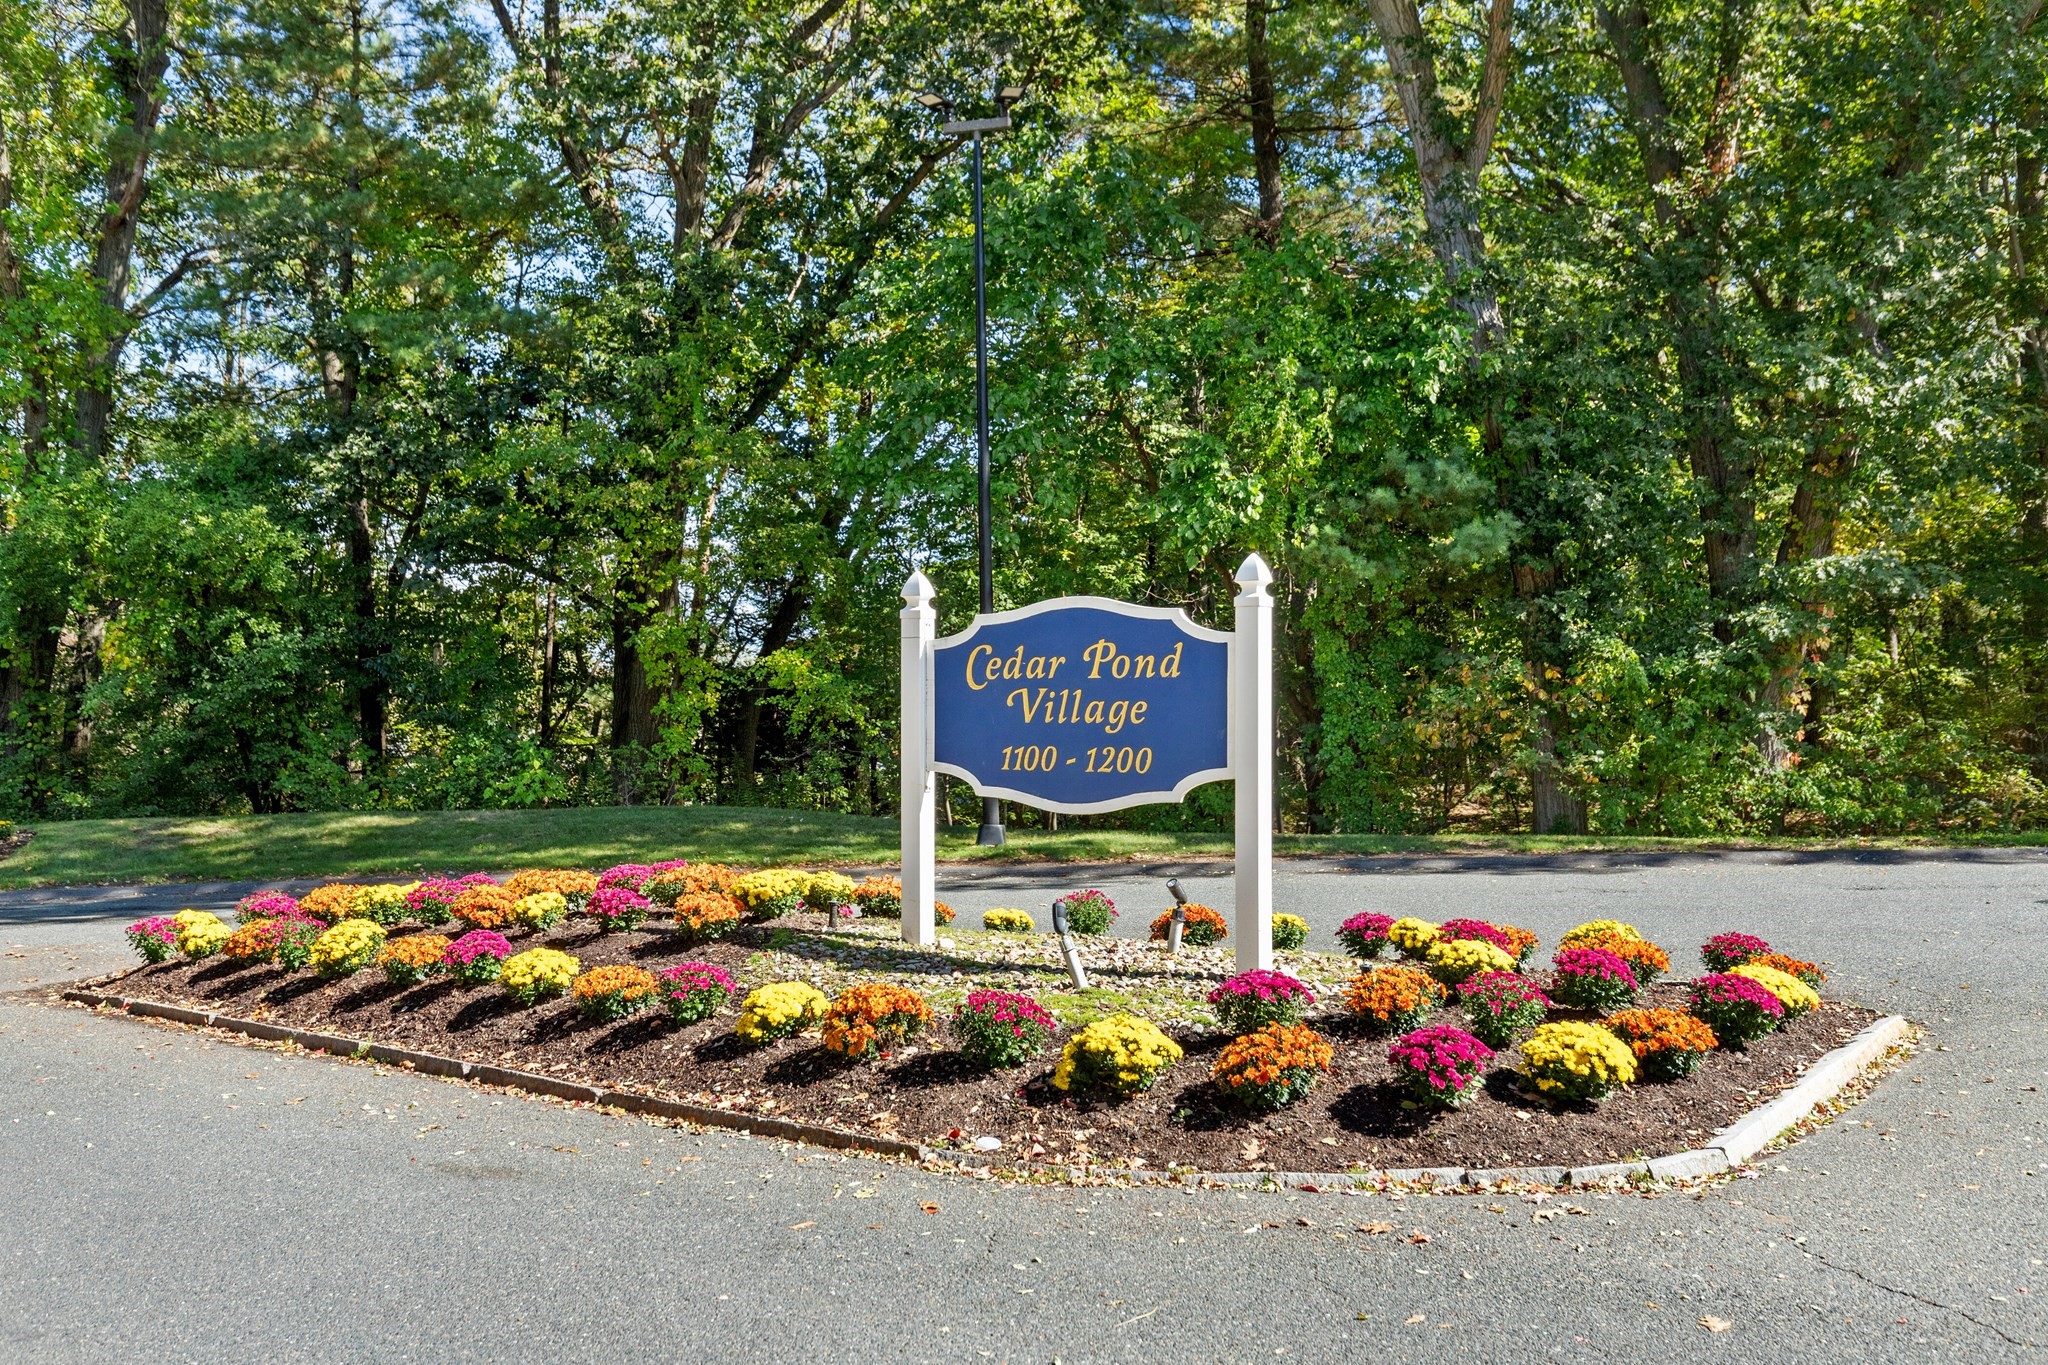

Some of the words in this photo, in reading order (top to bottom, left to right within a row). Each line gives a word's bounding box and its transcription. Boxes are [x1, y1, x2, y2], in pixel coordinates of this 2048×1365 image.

[965, 644, 1066, 691] Cedar
[1082, 638, 1184, 679] Pond
[1006, 687, 1148, 734] Village
[1001, 745, 1058, 772] 1100
[1065, 757, 1077, 766] -
[1085, 746, 1153, 774] 1200
